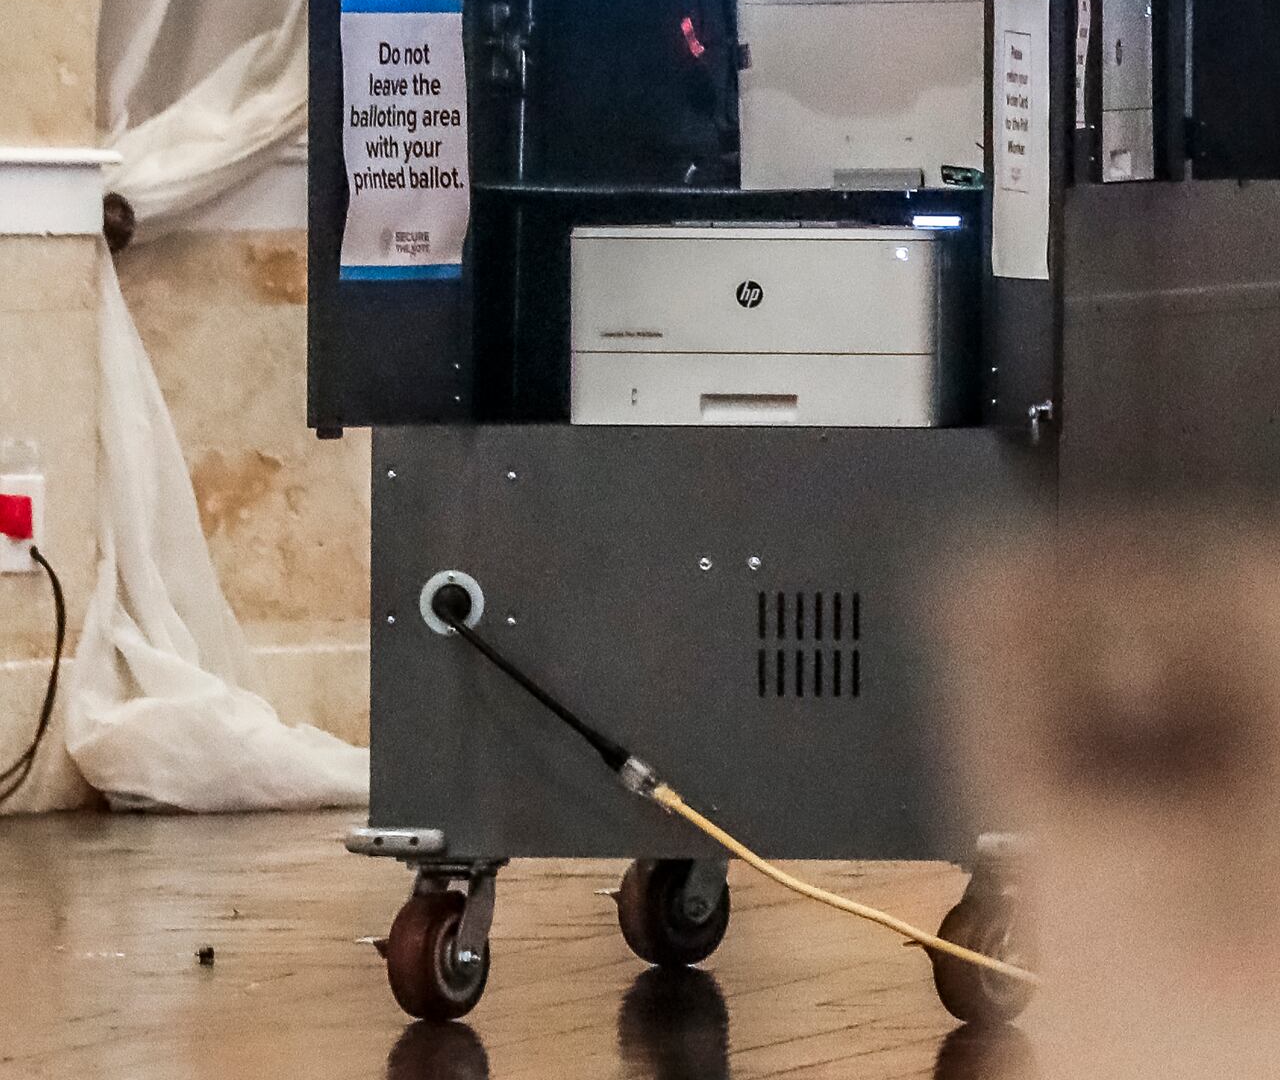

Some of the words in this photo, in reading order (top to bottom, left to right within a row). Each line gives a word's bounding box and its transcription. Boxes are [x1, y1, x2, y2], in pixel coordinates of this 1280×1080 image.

[379, 42, 400, 64] Do
[404, 42, 430, 64] not
[369, 74, 408, 96] leave
[413, 74, 441, 96] the
[350, 105, 417, 133] balloting
[422, 110, 461, 127] area
[366, 136, 398, 158] with
[404, 140, 442, 164] your
[354, 167, 406, 195] printed
[410, 168, 464, 190] ballot.
[739, 280, 763, 308] hp
